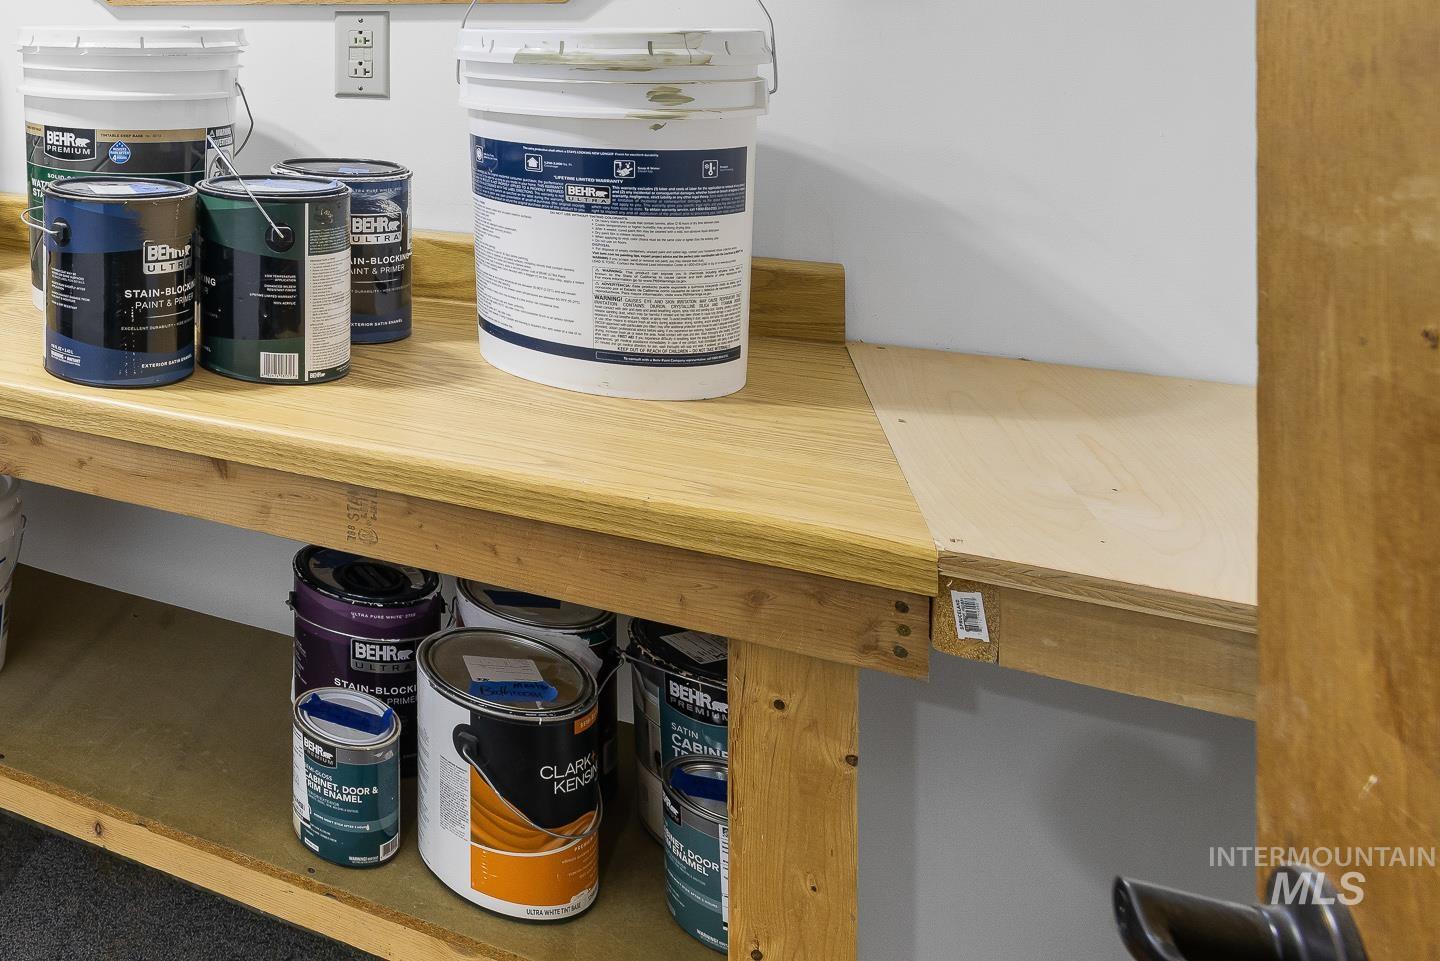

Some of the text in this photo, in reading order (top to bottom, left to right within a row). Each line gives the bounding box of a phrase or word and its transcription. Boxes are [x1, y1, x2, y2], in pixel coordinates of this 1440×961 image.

[46, 130, 75, 146] BEHR
[46, 144, 91, 155] PREMIUM
[567, 185, 596, 197] BEHR
[351, 216, 389, 233] BEHR
[351, 234, 399, 243] ULTRA
[147, 258, 192, 273] ULTRA
[371, 267, 378, 275] &
[380, 263, 405, 274] PRIMER
[135, 291, 195, 310] PAINT & PRIMER
[594, 294, 623, 302] WARNING!
[141, 360, 168, 369] EXTERIOR
[354, 642, 398, 661] BEHR
[355, 661, 414, 672] ULTRA
[669, 680, 712, 710] BEHR
[671, 722, 699, 740] SATIN
[303, 736, 324, 756] BEHR
[539, 752, 592, 780] CLARK
[323, 789, 363, 804] ENAMEL
[342, 785, 370, 795] DOOR
[372, 786, 379, 794] &
[672, 844, 710, 877] ENAMEL
[687, 849, 720, 873] DOOR
[526, 902, 582, 916] ULTRA WHITE TINT BASE
